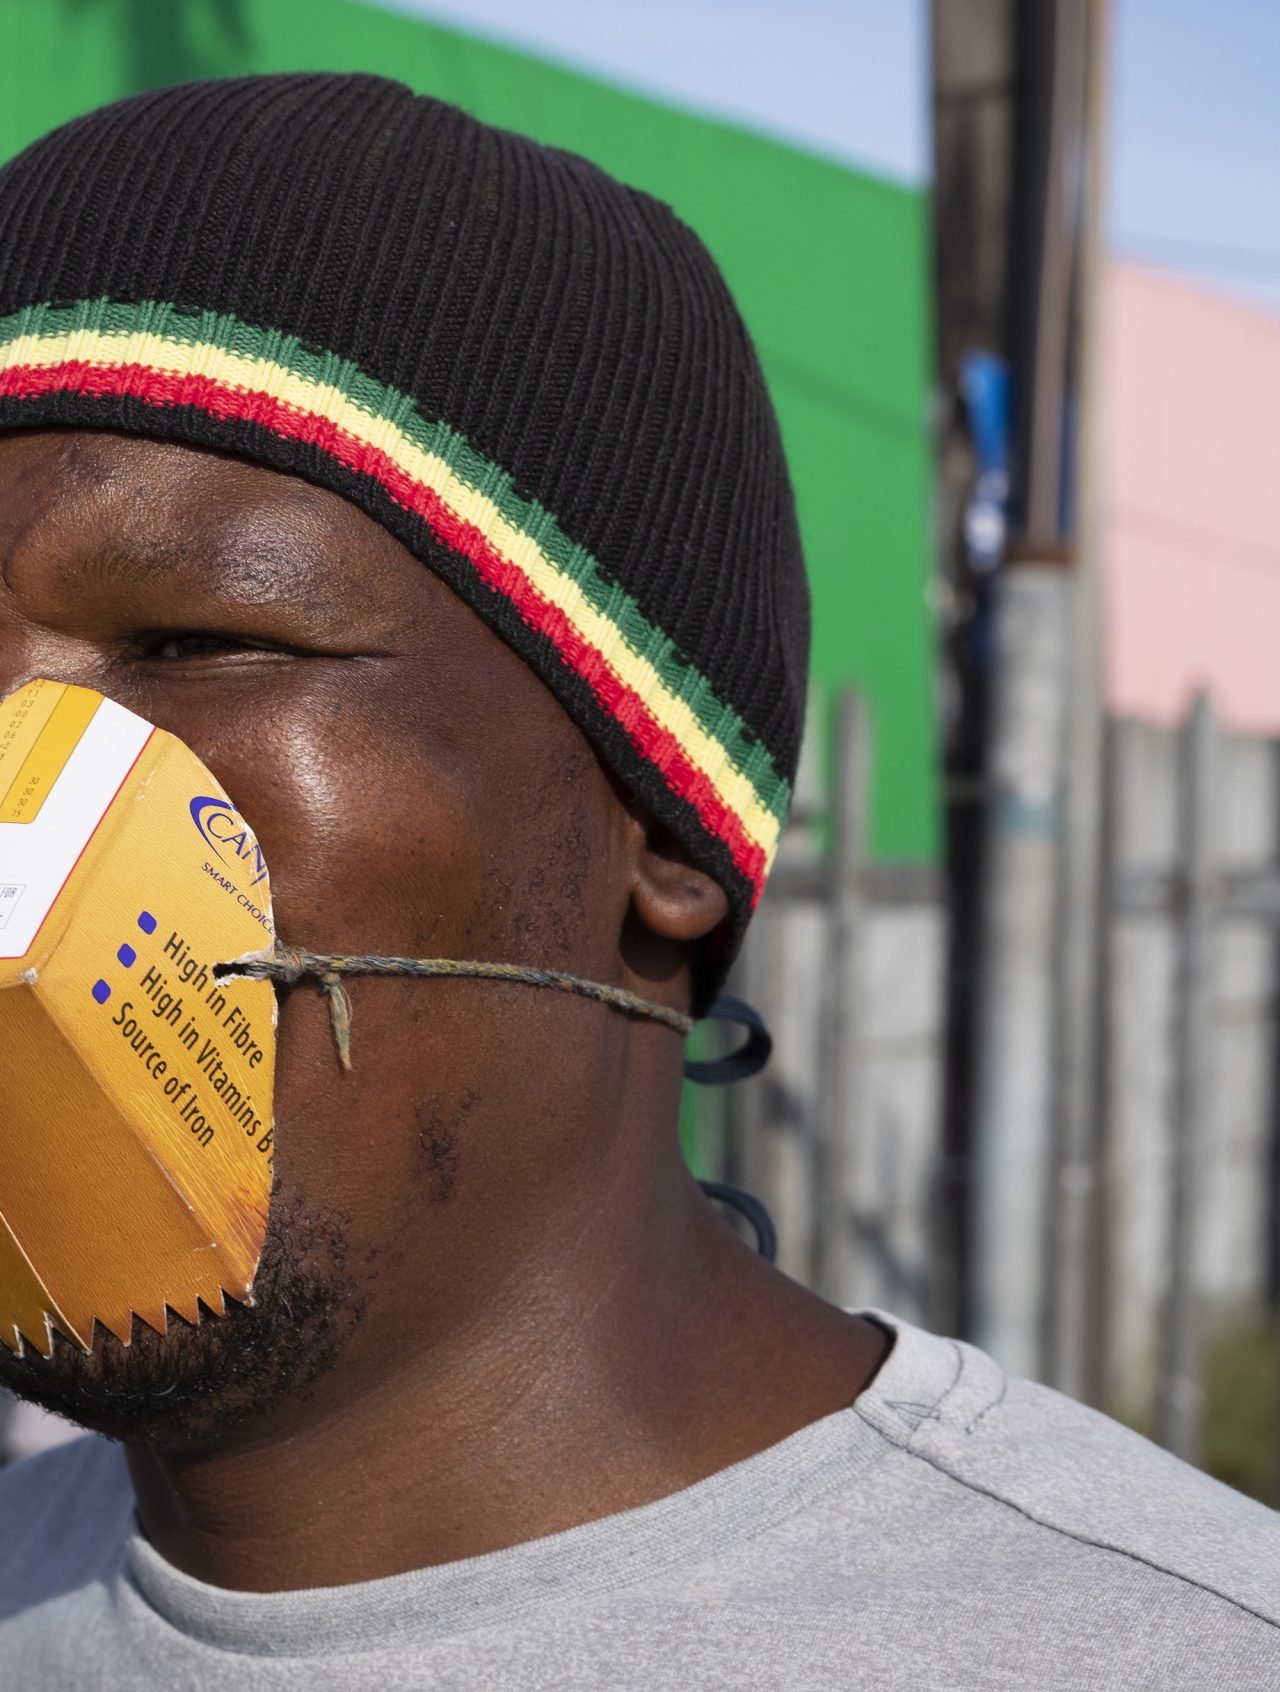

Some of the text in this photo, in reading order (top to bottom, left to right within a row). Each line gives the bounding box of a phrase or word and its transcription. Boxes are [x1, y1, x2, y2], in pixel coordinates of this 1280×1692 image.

[0, 886, 18, 899] FOR
[201, 862, 238, 895] SMART
[206, 812, 268, 887] CAN
[139, 965, 183, 1027] High
[178, 1016, 200, 1051] in
[196, 1039, 262, 1137] Vitamins
[163, 932, 264, 1069] High in Fibre
[112, 1002, 215, 1148] Source of Iron
